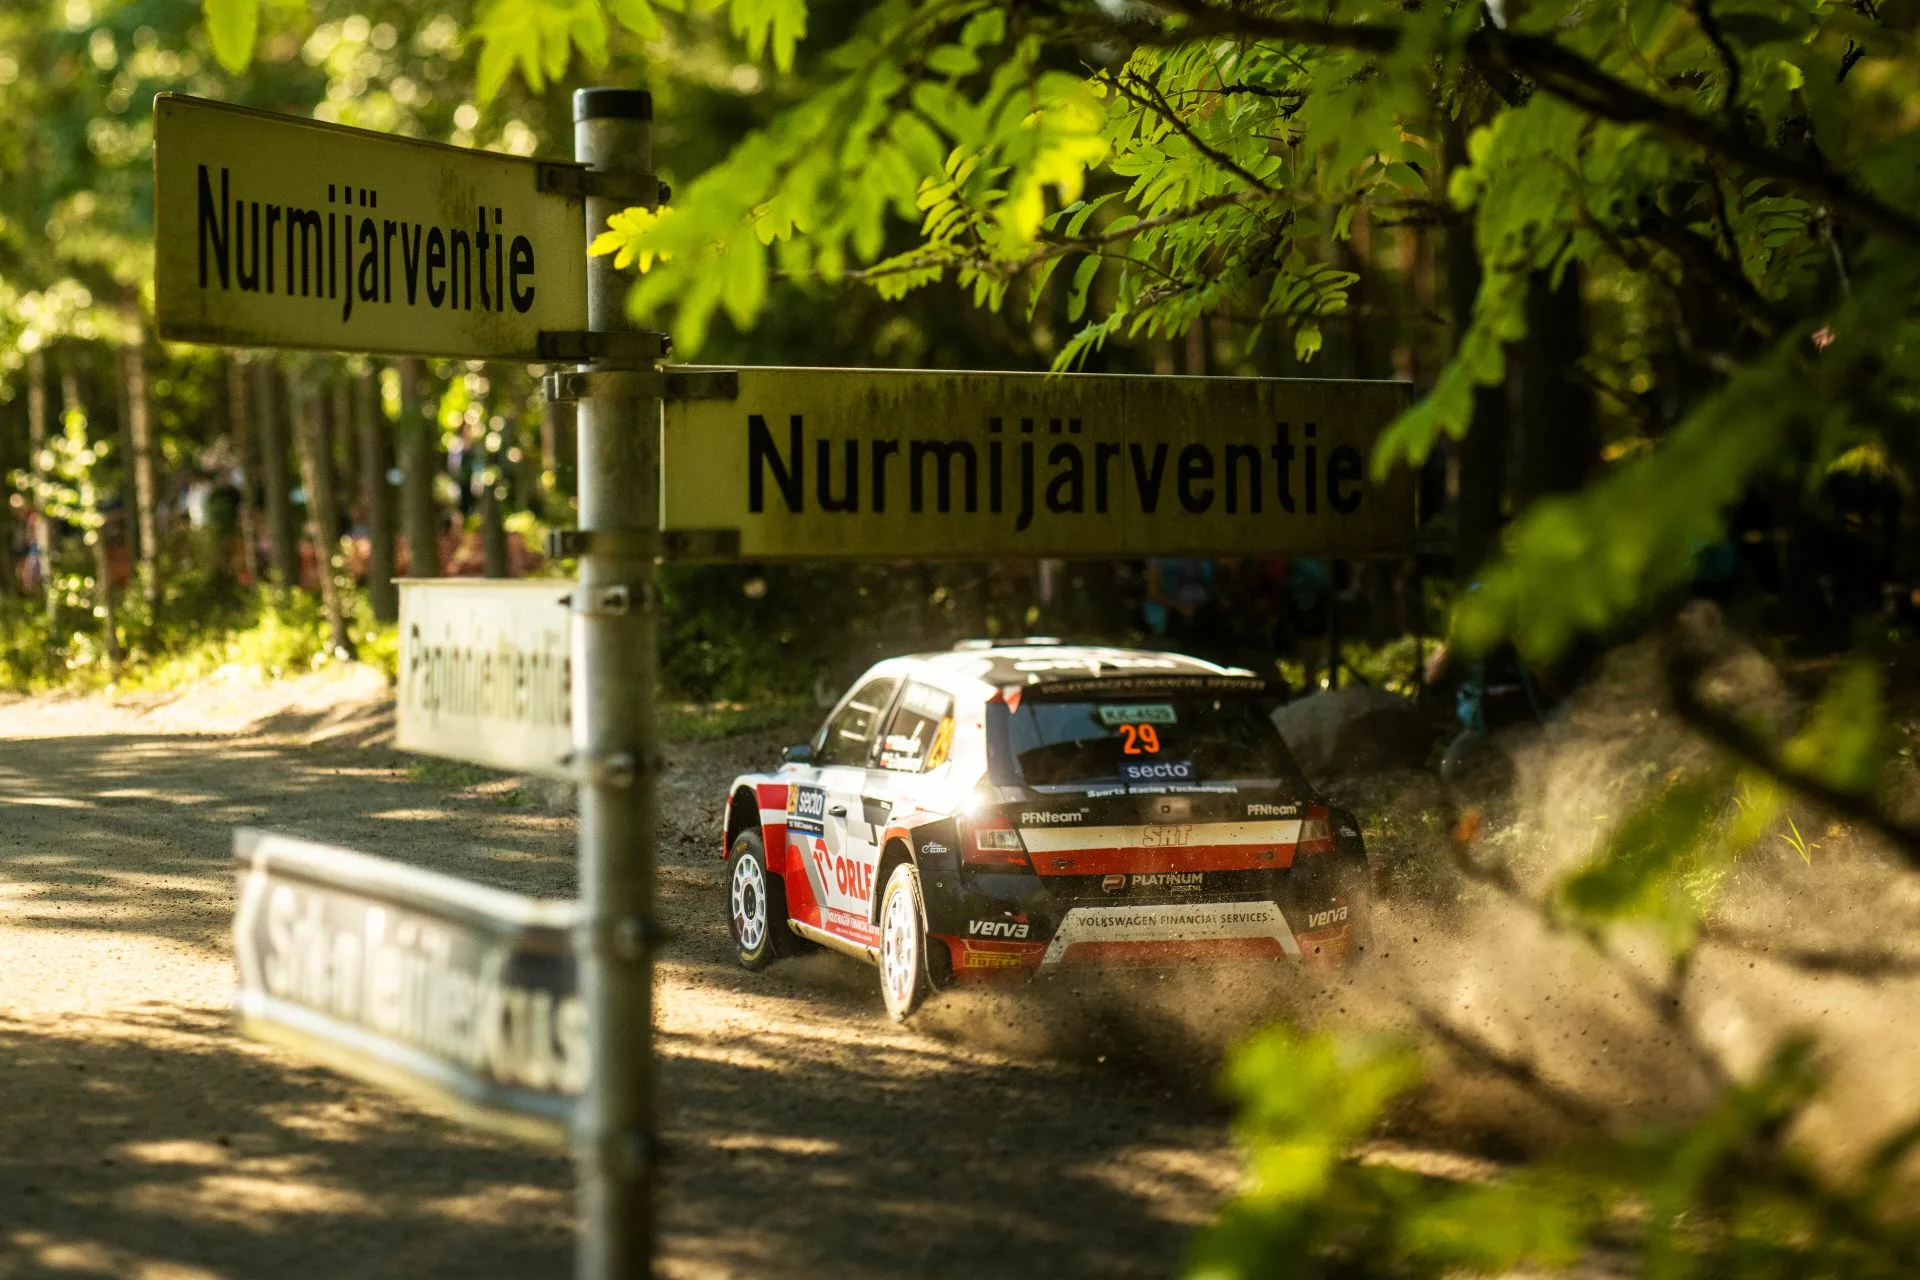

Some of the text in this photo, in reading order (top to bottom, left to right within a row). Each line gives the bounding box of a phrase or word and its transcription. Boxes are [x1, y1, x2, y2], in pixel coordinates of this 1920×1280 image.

[197, 163, 535, 323] Nurmijärventie
[746, 413, 1364, 532] Nurmijärventie
[1119, 723, 1160, 755] 29
[1127, 762, 1189, 778] secto
[1087, 785, 1239, 798] Sports Racing Technologies
[798, 788, 824, 816] secto
[1247, 803, 1297, 816] PFNteam
[1021, 811, 1082, 824] PFNteam
[1143, 824, 1193, 847] SRT
[835, 855, 875, 903] ORLE
[1132, 872, 1203, 886] PLATINUM
[1079, 912, 1269, 927] VOLKSWAGEN FINANCIAL SERVICES
[1308, 906, 1348, 928] verva
[969, 920, 1030, 938] verva
